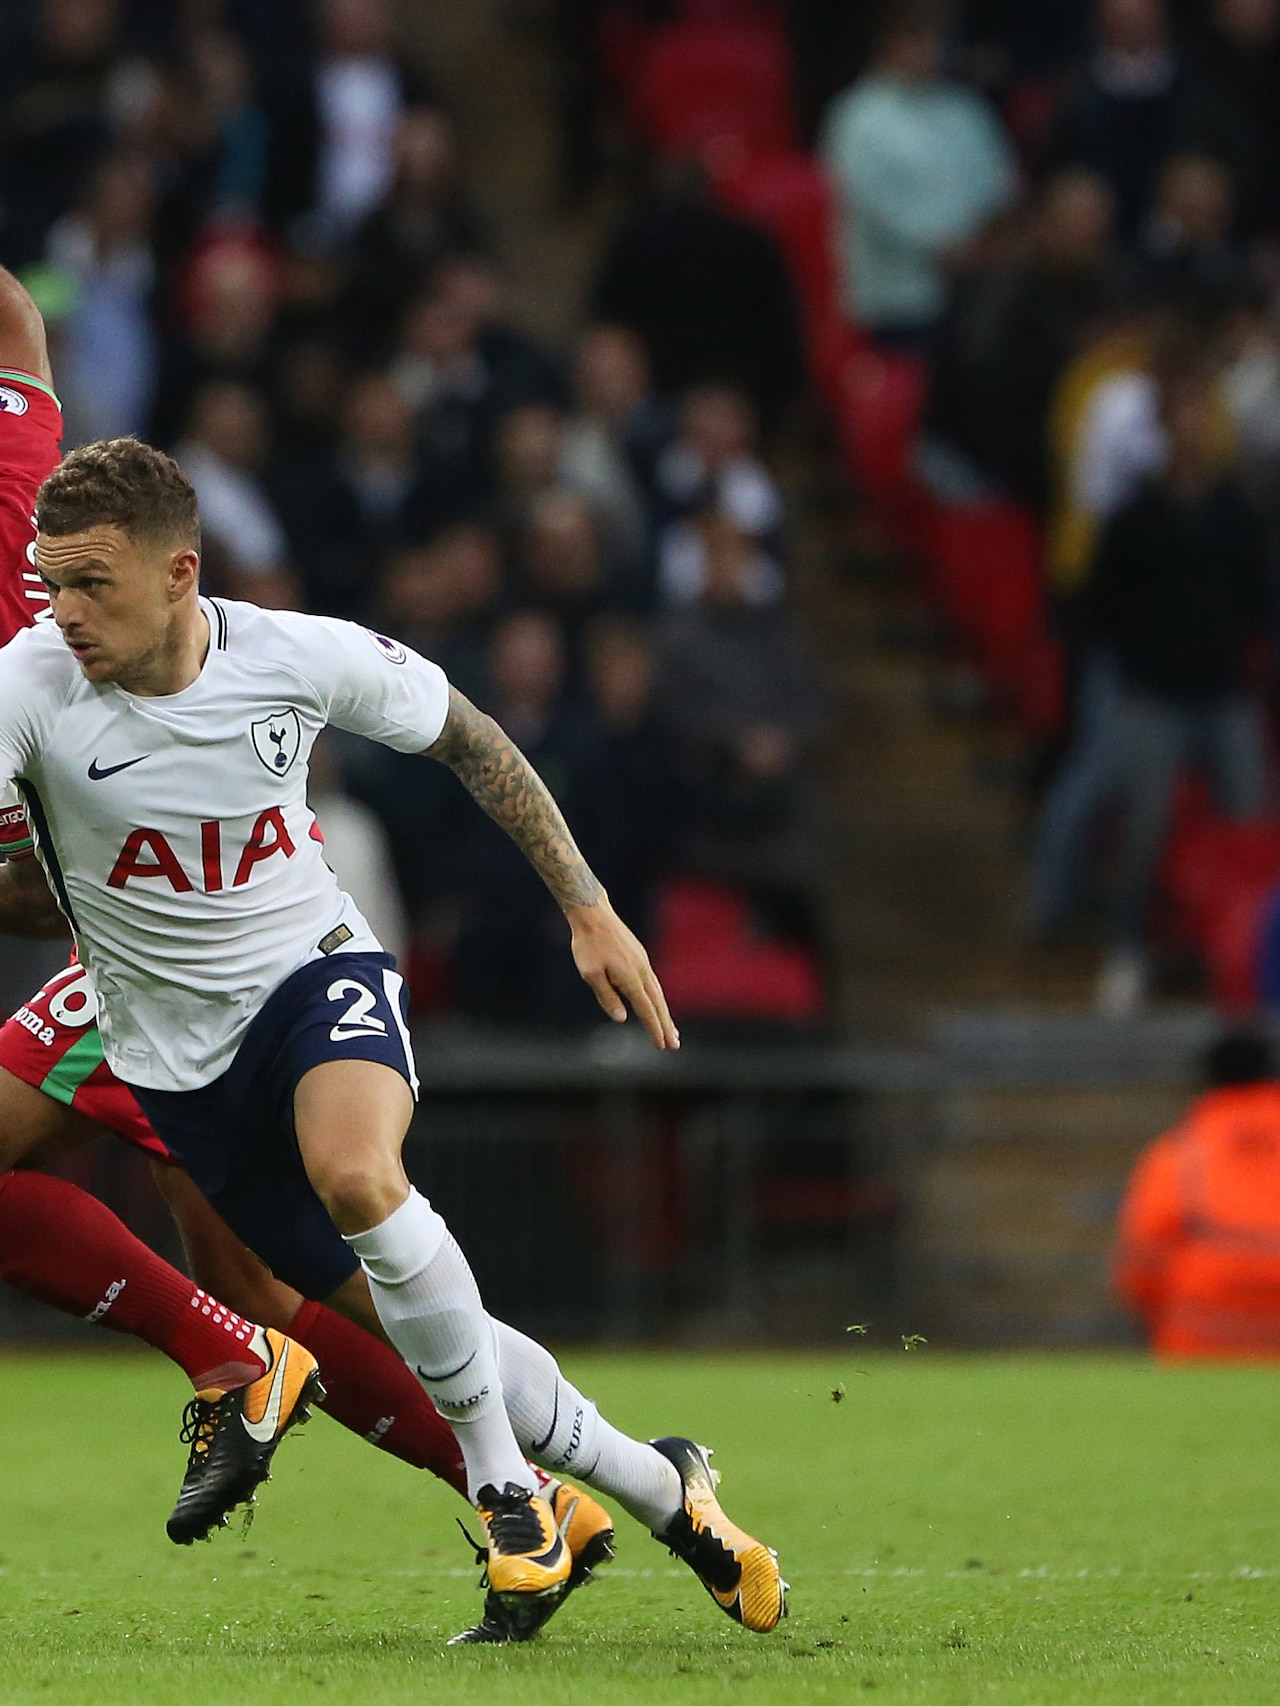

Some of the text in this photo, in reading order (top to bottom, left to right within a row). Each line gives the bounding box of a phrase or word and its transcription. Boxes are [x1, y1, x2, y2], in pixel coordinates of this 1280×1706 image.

[106, 805, 297, 893] AIA
[326, 978, 387, 1033] 2
[552, 1405, 585, 1469] SPURS
